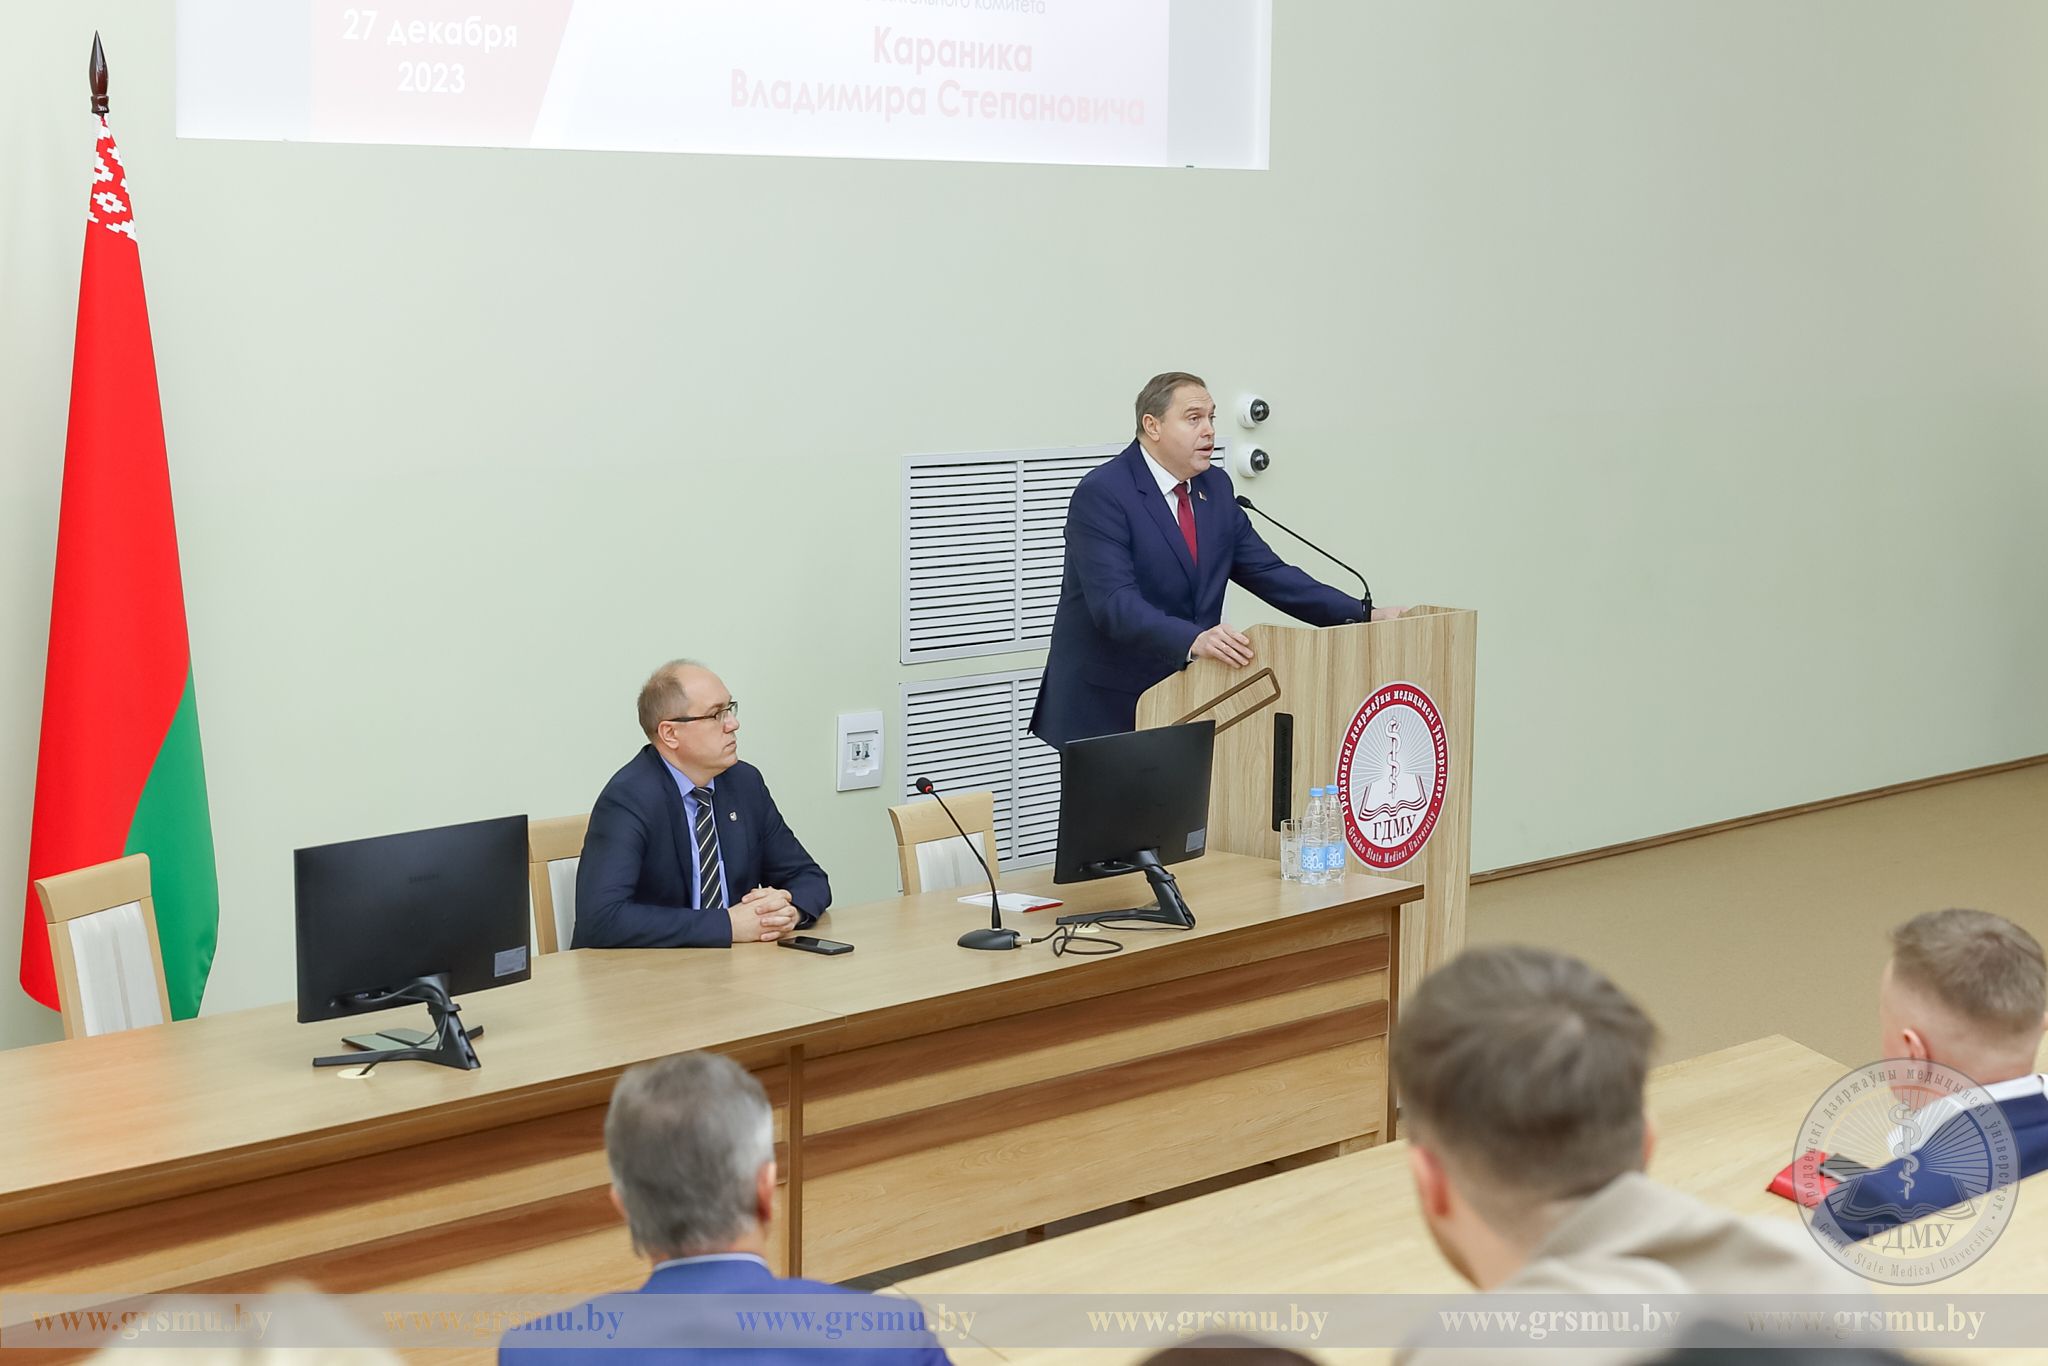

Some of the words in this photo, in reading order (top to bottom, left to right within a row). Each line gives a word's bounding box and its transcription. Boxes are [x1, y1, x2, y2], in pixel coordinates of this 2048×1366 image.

[342, 8, 378, 41] 27
[386, 14, 518, 53] декабря
[873, 25, 1033, 75] Караника
[397, 60, 466, 94] 2023
[730, 68, 926, 124] Владимира
[937, 79, 1146, 127] Степановича
[1350, 691, 1391, 742] дзяржаўны
[1393, 690, 1438, 726] медыцынскі
[1348, 826, 1366, 854] Grodno
[1366, 847, 1381, 863] State
[1384, 846, 1408, 863] Medical
[1409, 810, 1437, 851] University
[1373, 814, 1416, 845] ГДМУ
